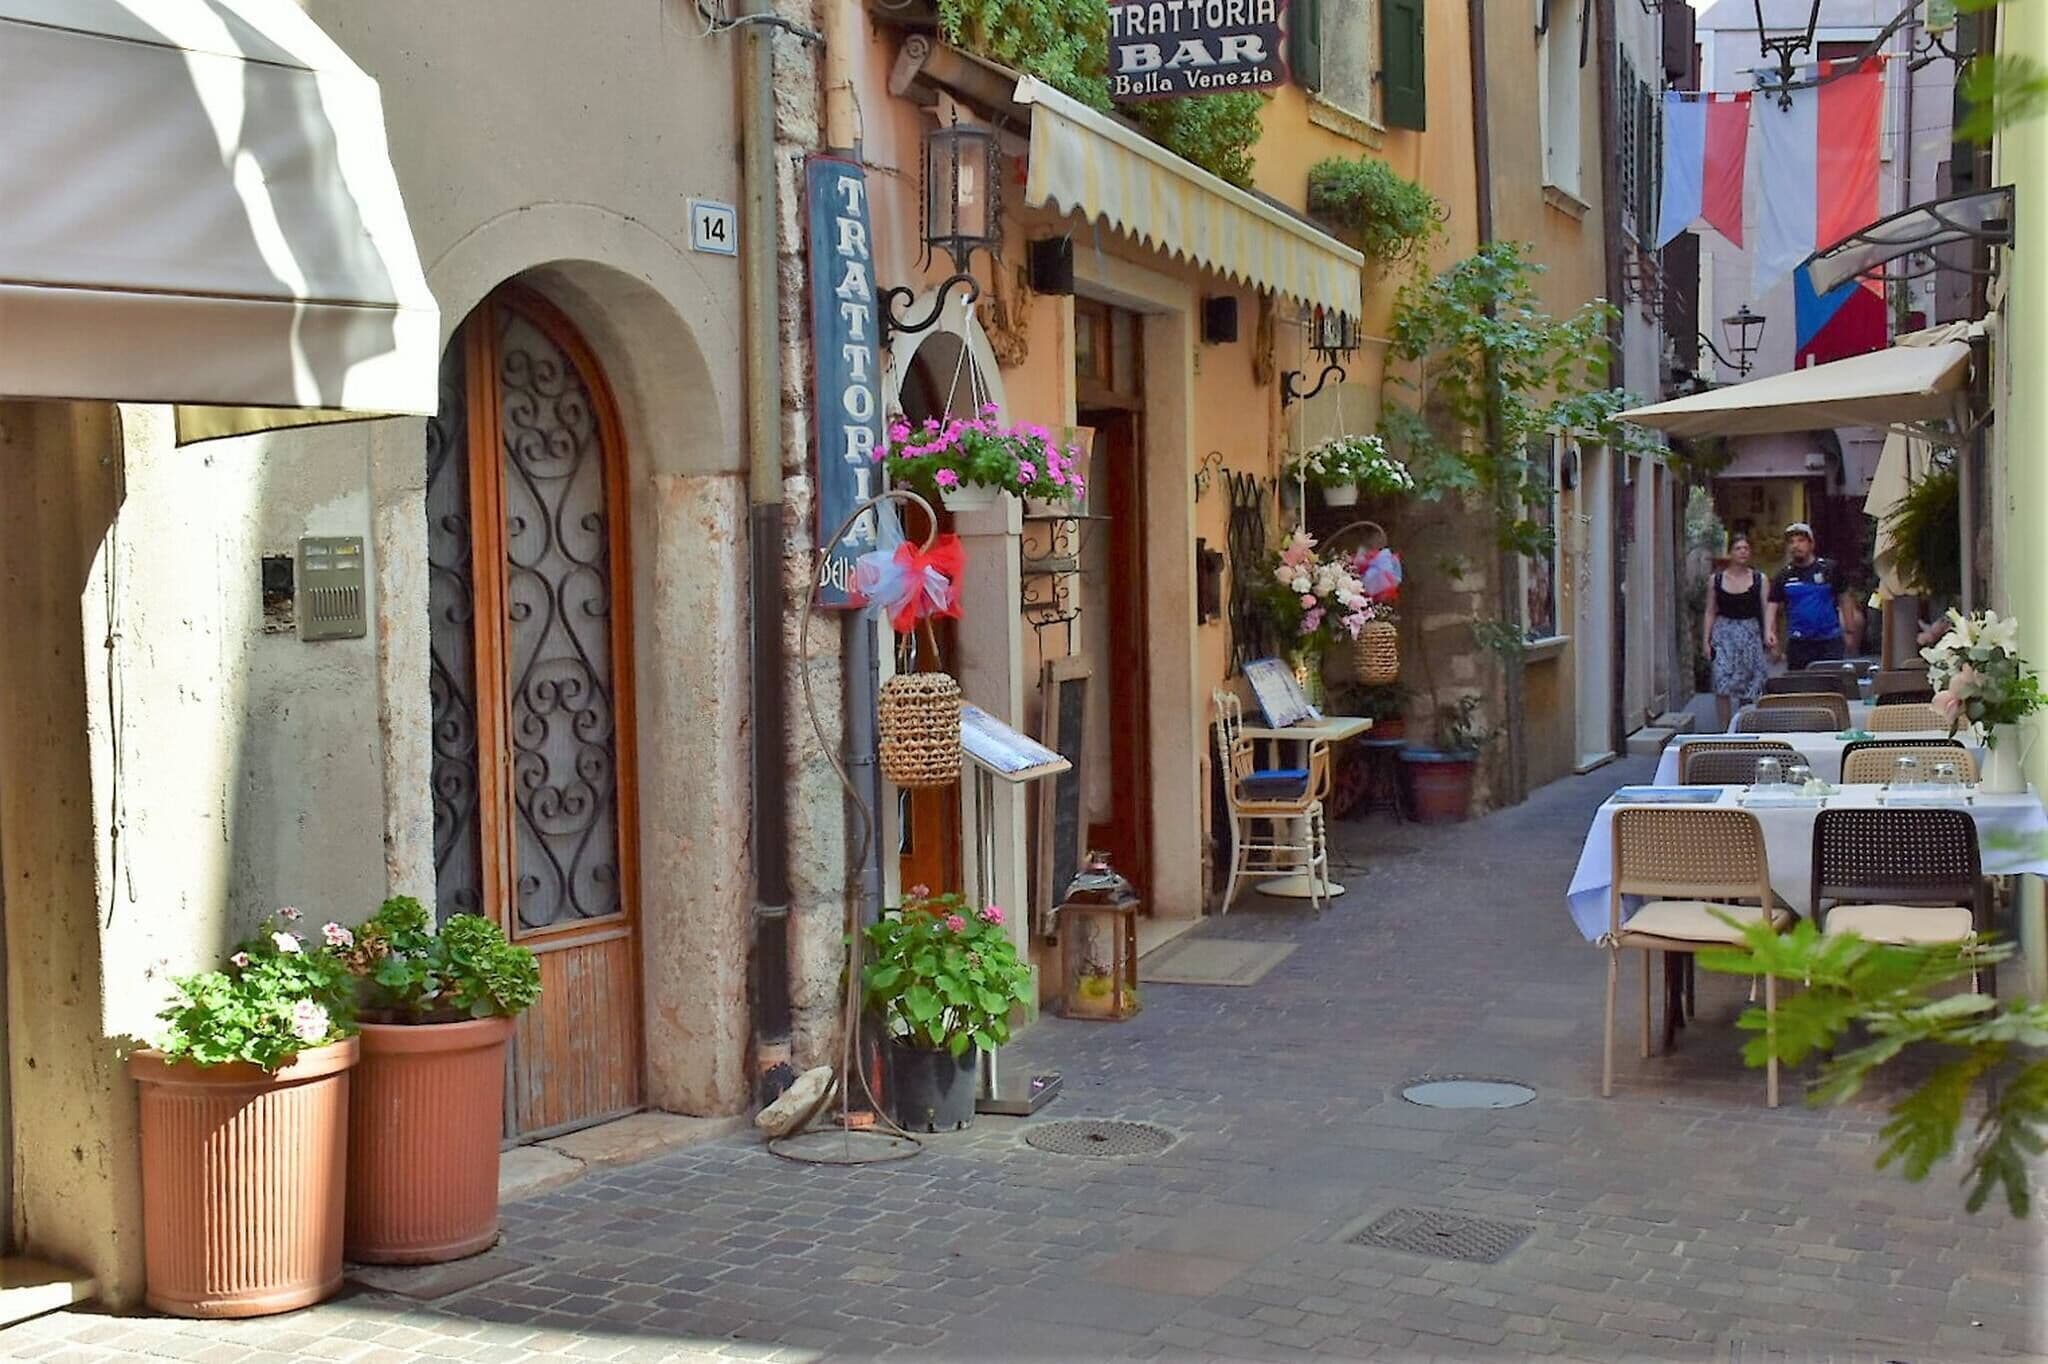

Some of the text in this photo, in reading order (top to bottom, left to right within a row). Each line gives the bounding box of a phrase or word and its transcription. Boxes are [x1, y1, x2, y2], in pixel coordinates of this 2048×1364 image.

[1108, 0, 1276, 37] TRATTORIA
[1117, 34, 1267, 73] BAR
[1114, 66, 1273, 95] Bella Venezia
[703, 216, 725, 242] 14
[836, 175, 876, 547] TRATTORIA
